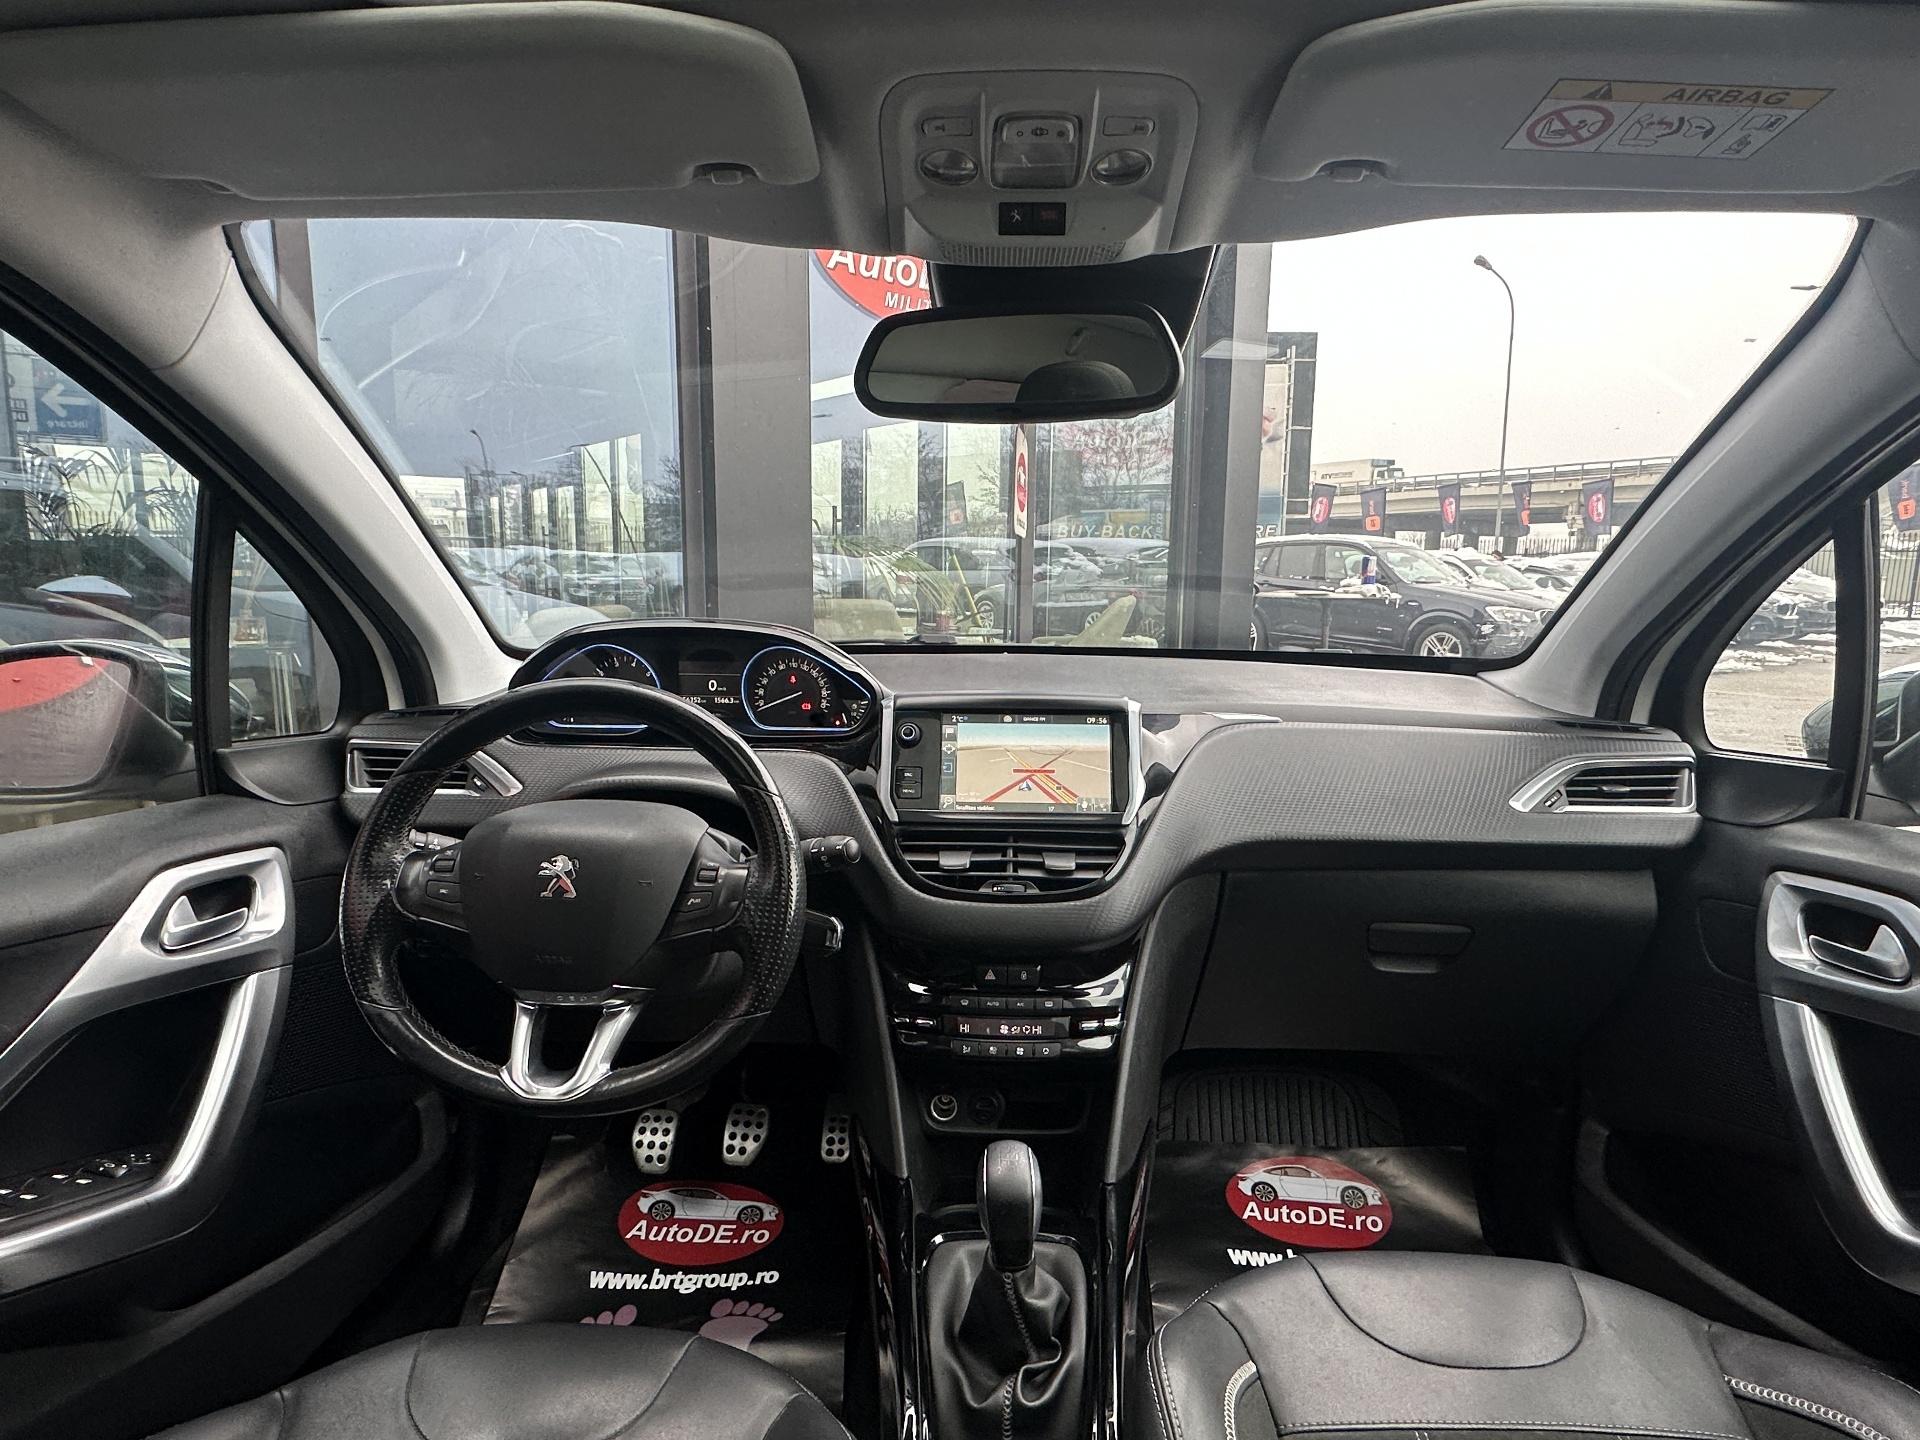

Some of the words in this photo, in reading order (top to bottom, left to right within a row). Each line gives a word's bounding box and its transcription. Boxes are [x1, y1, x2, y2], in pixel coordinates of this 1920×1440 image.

[1662, 88, 1791, 105] AIRBAG
[1057, 525, 1153, 538] BUY-BACK
[708, 679, 717, 691] 0
[959, 1023, 970, 1033] HI
[1032, 1025, 1042, 1035] HI
[1242, 1201, 1383, 1233] AutoDE.ro
[624, 1219, 771, 1245] AutoDE.ro
[589, 1268, 781, 1295] www.brtgroup.ro
